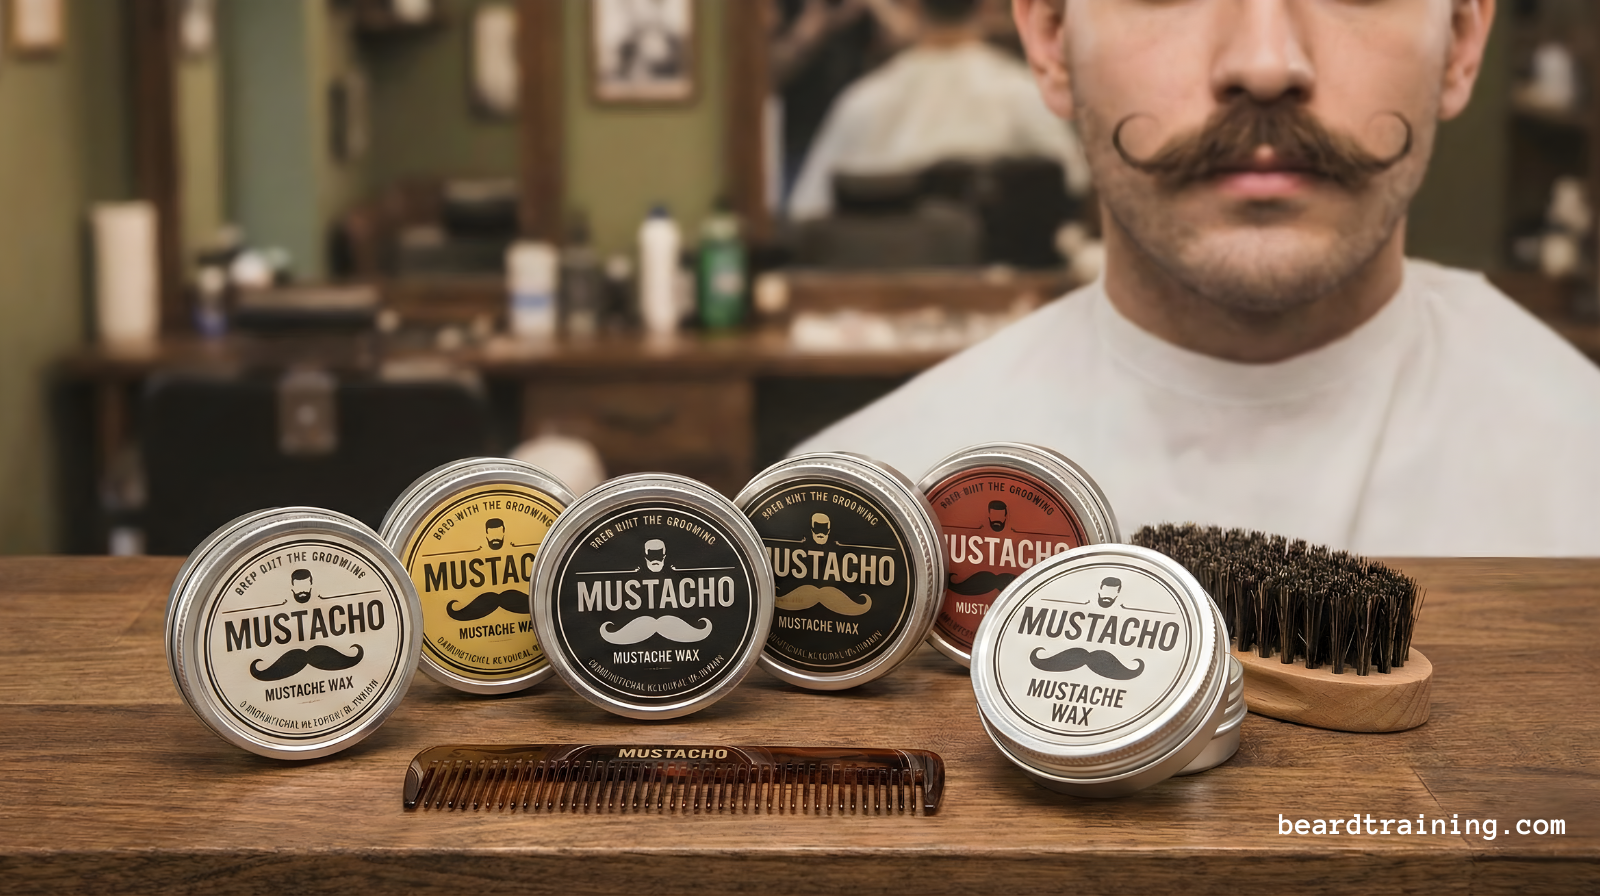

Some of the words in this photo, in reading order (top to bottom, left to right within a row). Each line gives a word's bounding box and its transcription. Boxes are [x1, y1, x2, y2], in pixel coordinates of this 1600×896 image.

[988, 482, 1005, 492] THE
[810, 492, 828, 502] THE
[455, 504, 479, 521] WITH
[483, 501, 501, 510] THE
[643, 515, 662, 525] THE
[287, 552, 307, 563] THE
[944, 534, 1070, 569] USTACH
[424, 552, 534, 592] MUSTAC
[577, 576, 735, 612] MUSTACHO
[956, 602, 989, 615] MUSTA
[225, 600, 384, 652] MUSTACHO
[459, 622, 515, 639] MUSTACHE
[518, 621, 533, 633] WA
[778, 616, 833, 632] MUSTACHE
[836, 621, 859, 635] WAX
[1018, 606, 1180, 651] MUSTACHO
[613, 650, 672, 664] MUSTACHE
[674, 649, 700, 662] WAX
[265, 681, 326, 702] MUSTACHE
[328, 676, 354, 691] WAX
[1027, 678, 1127, 709] MUSTACHE
[1051, 703, 1093, 727] WAX
[618, 749, 728, 759] MUSTACHO
